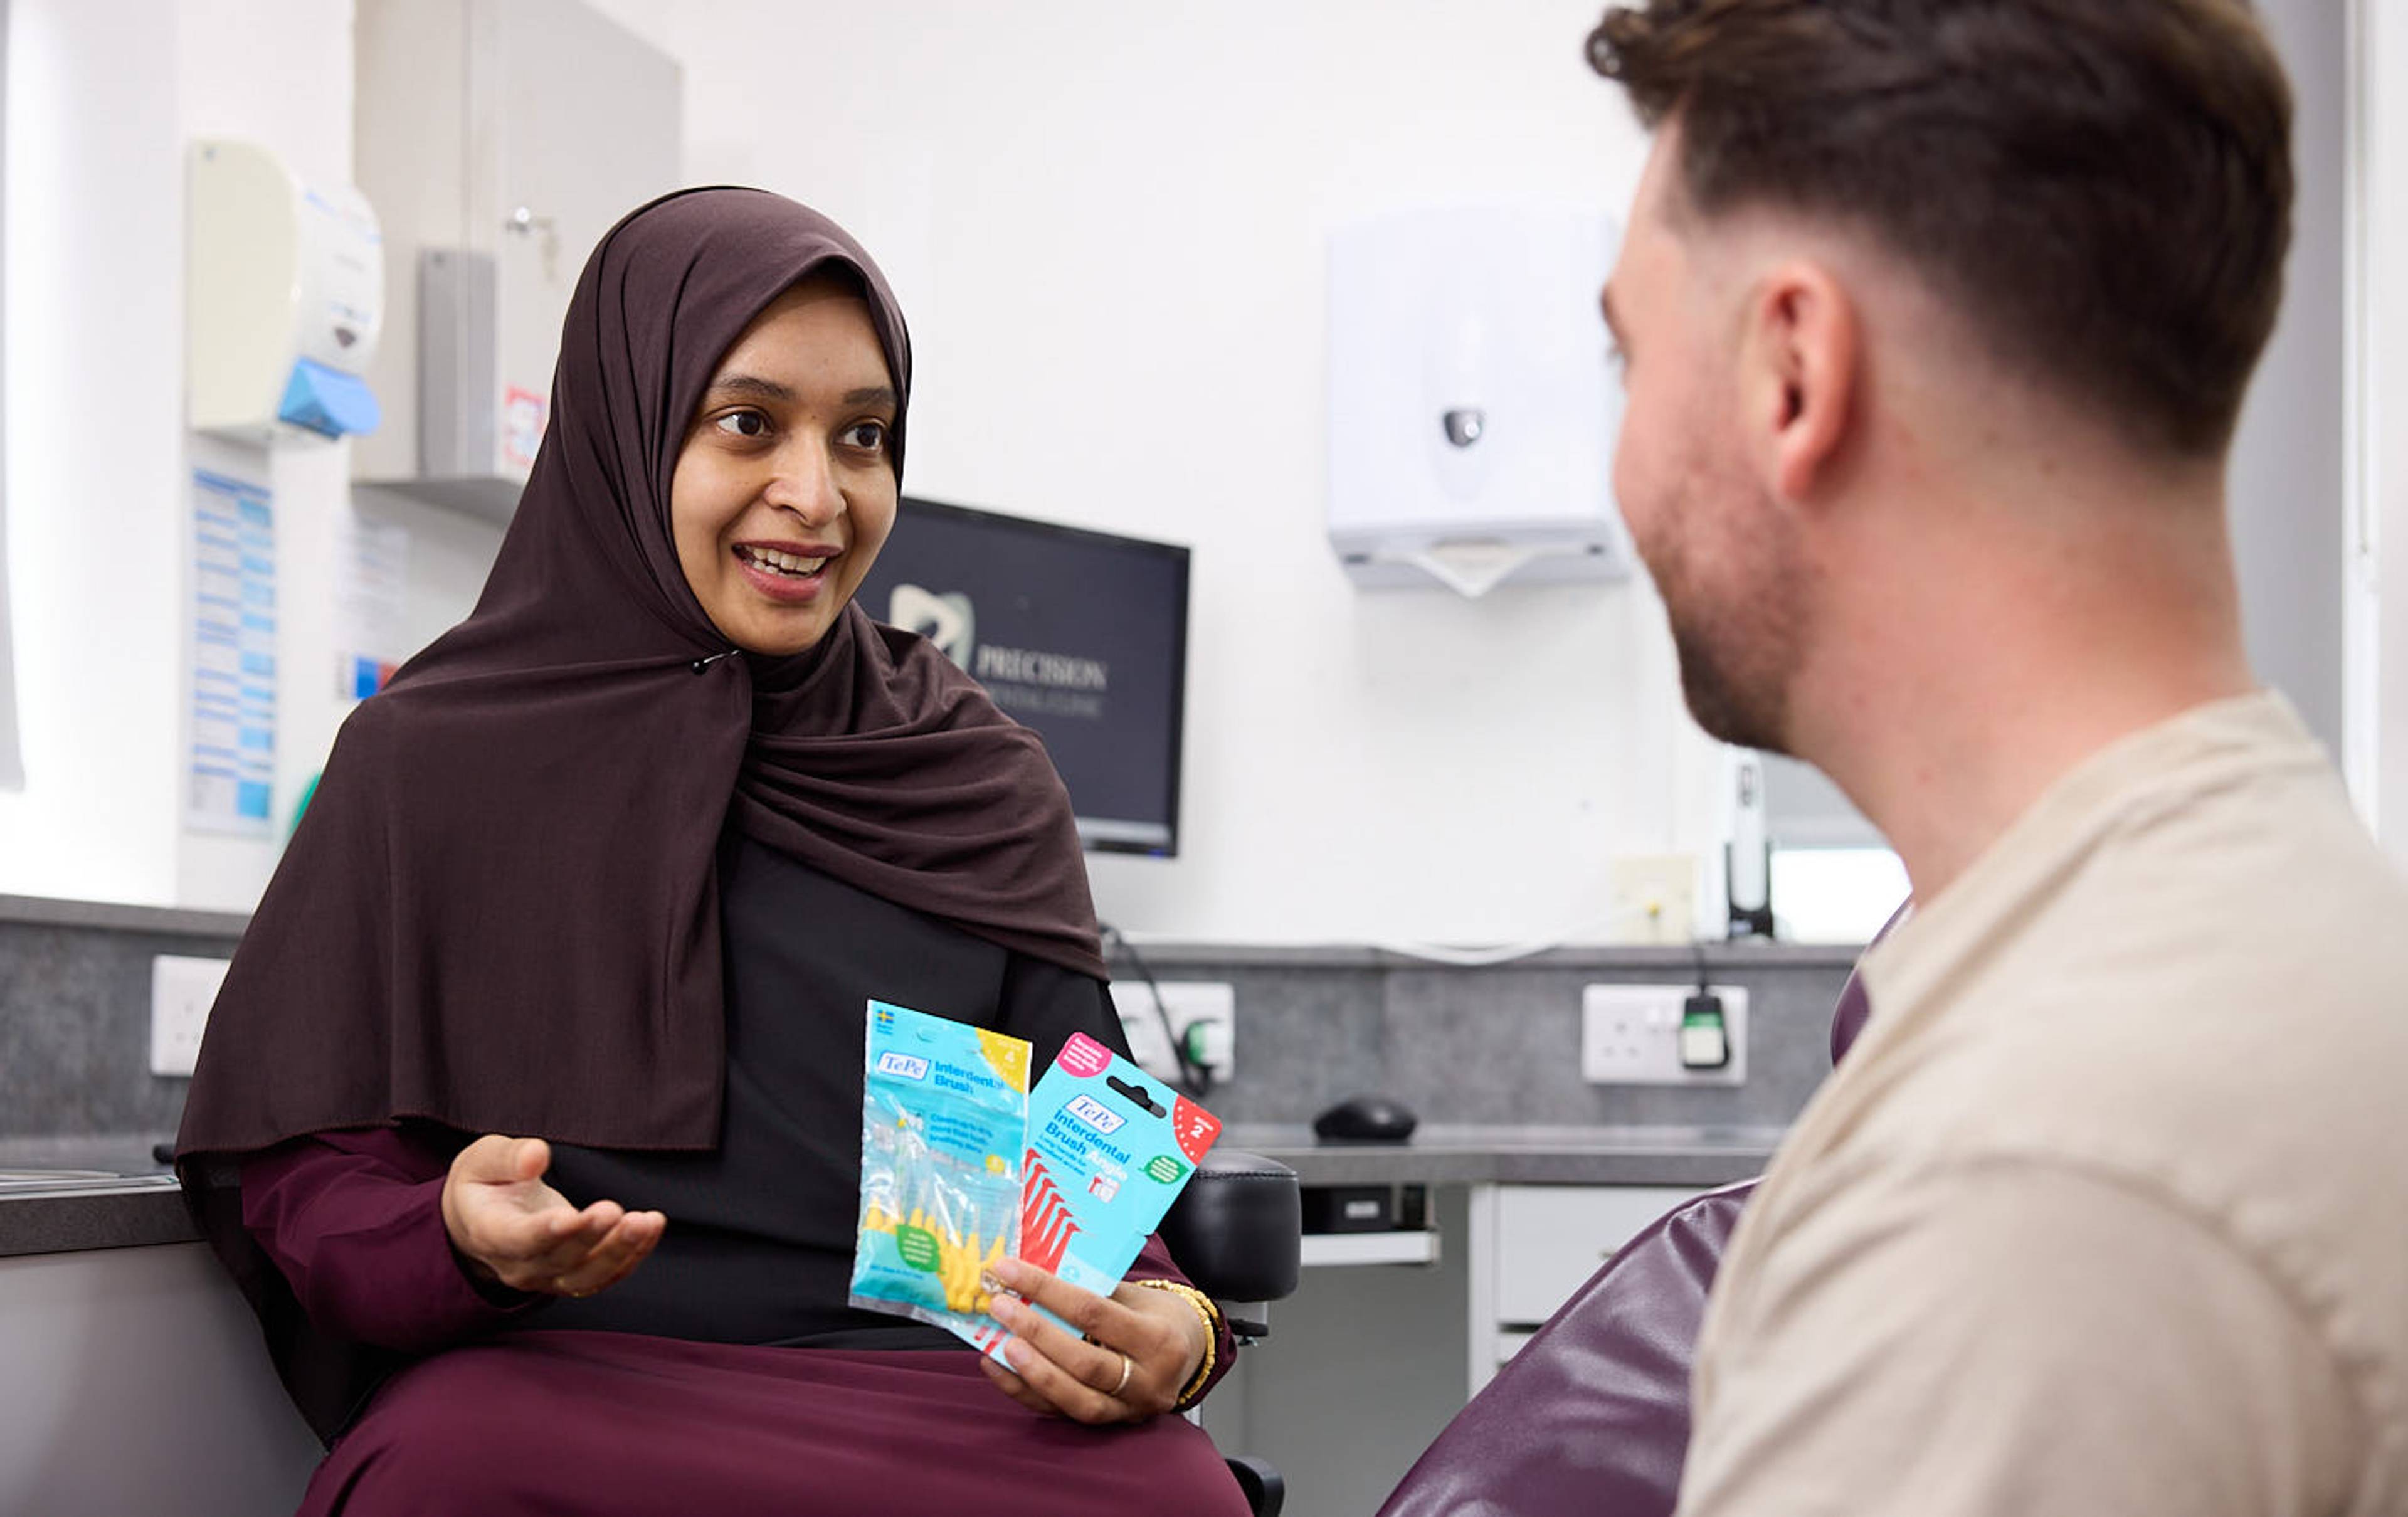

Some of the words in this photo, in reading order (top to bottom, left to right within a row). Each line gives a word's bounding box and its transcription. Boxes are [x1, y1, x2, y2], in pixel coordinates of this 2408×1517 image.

[885, 1055, 922, 1075] TePe
[1076, 1099, 1114, 1129] TePe
[1045, 1121, 1087, 1155] Brush
[1054, 1109, 1131, 1165] Interdental
[1190, 1124, 1205, 1139] 2
